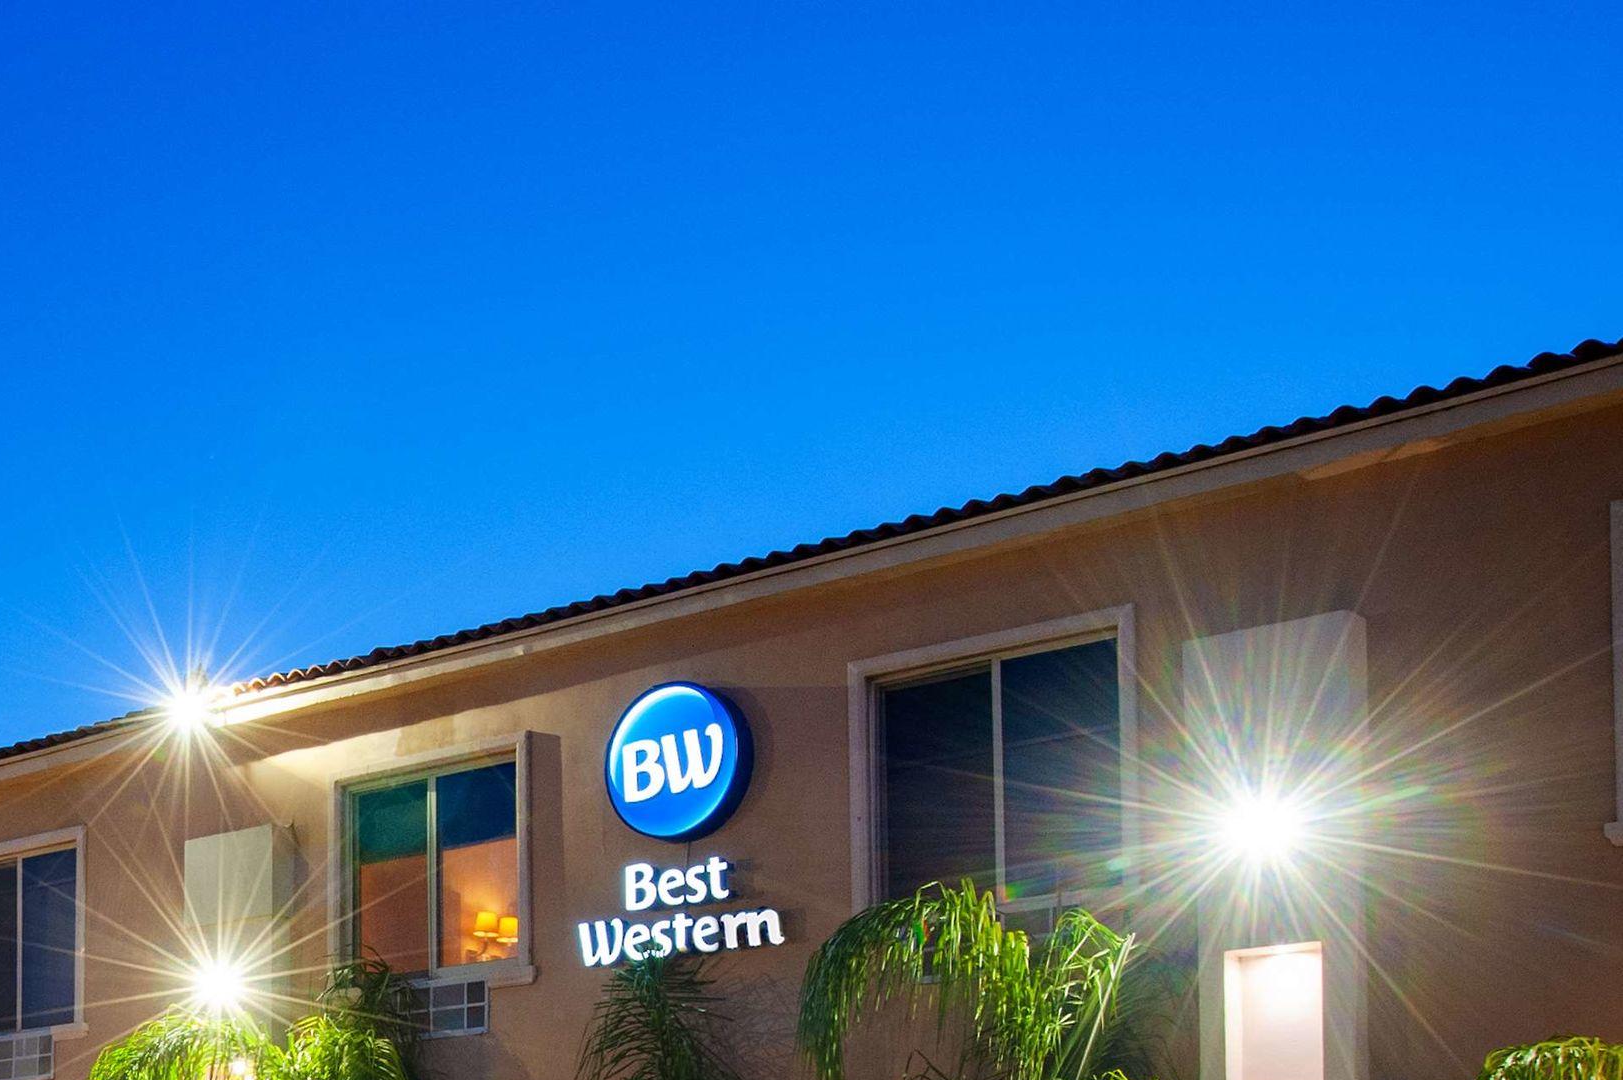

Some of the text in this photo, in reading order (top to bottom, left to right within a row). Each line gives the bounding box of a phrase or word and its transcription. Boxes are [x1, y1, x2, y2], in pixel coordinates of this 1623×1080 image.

[622, 723, 724, 803] BW
[624, 856, 730, 911] Best
[577, 908, 786, 967] Western
